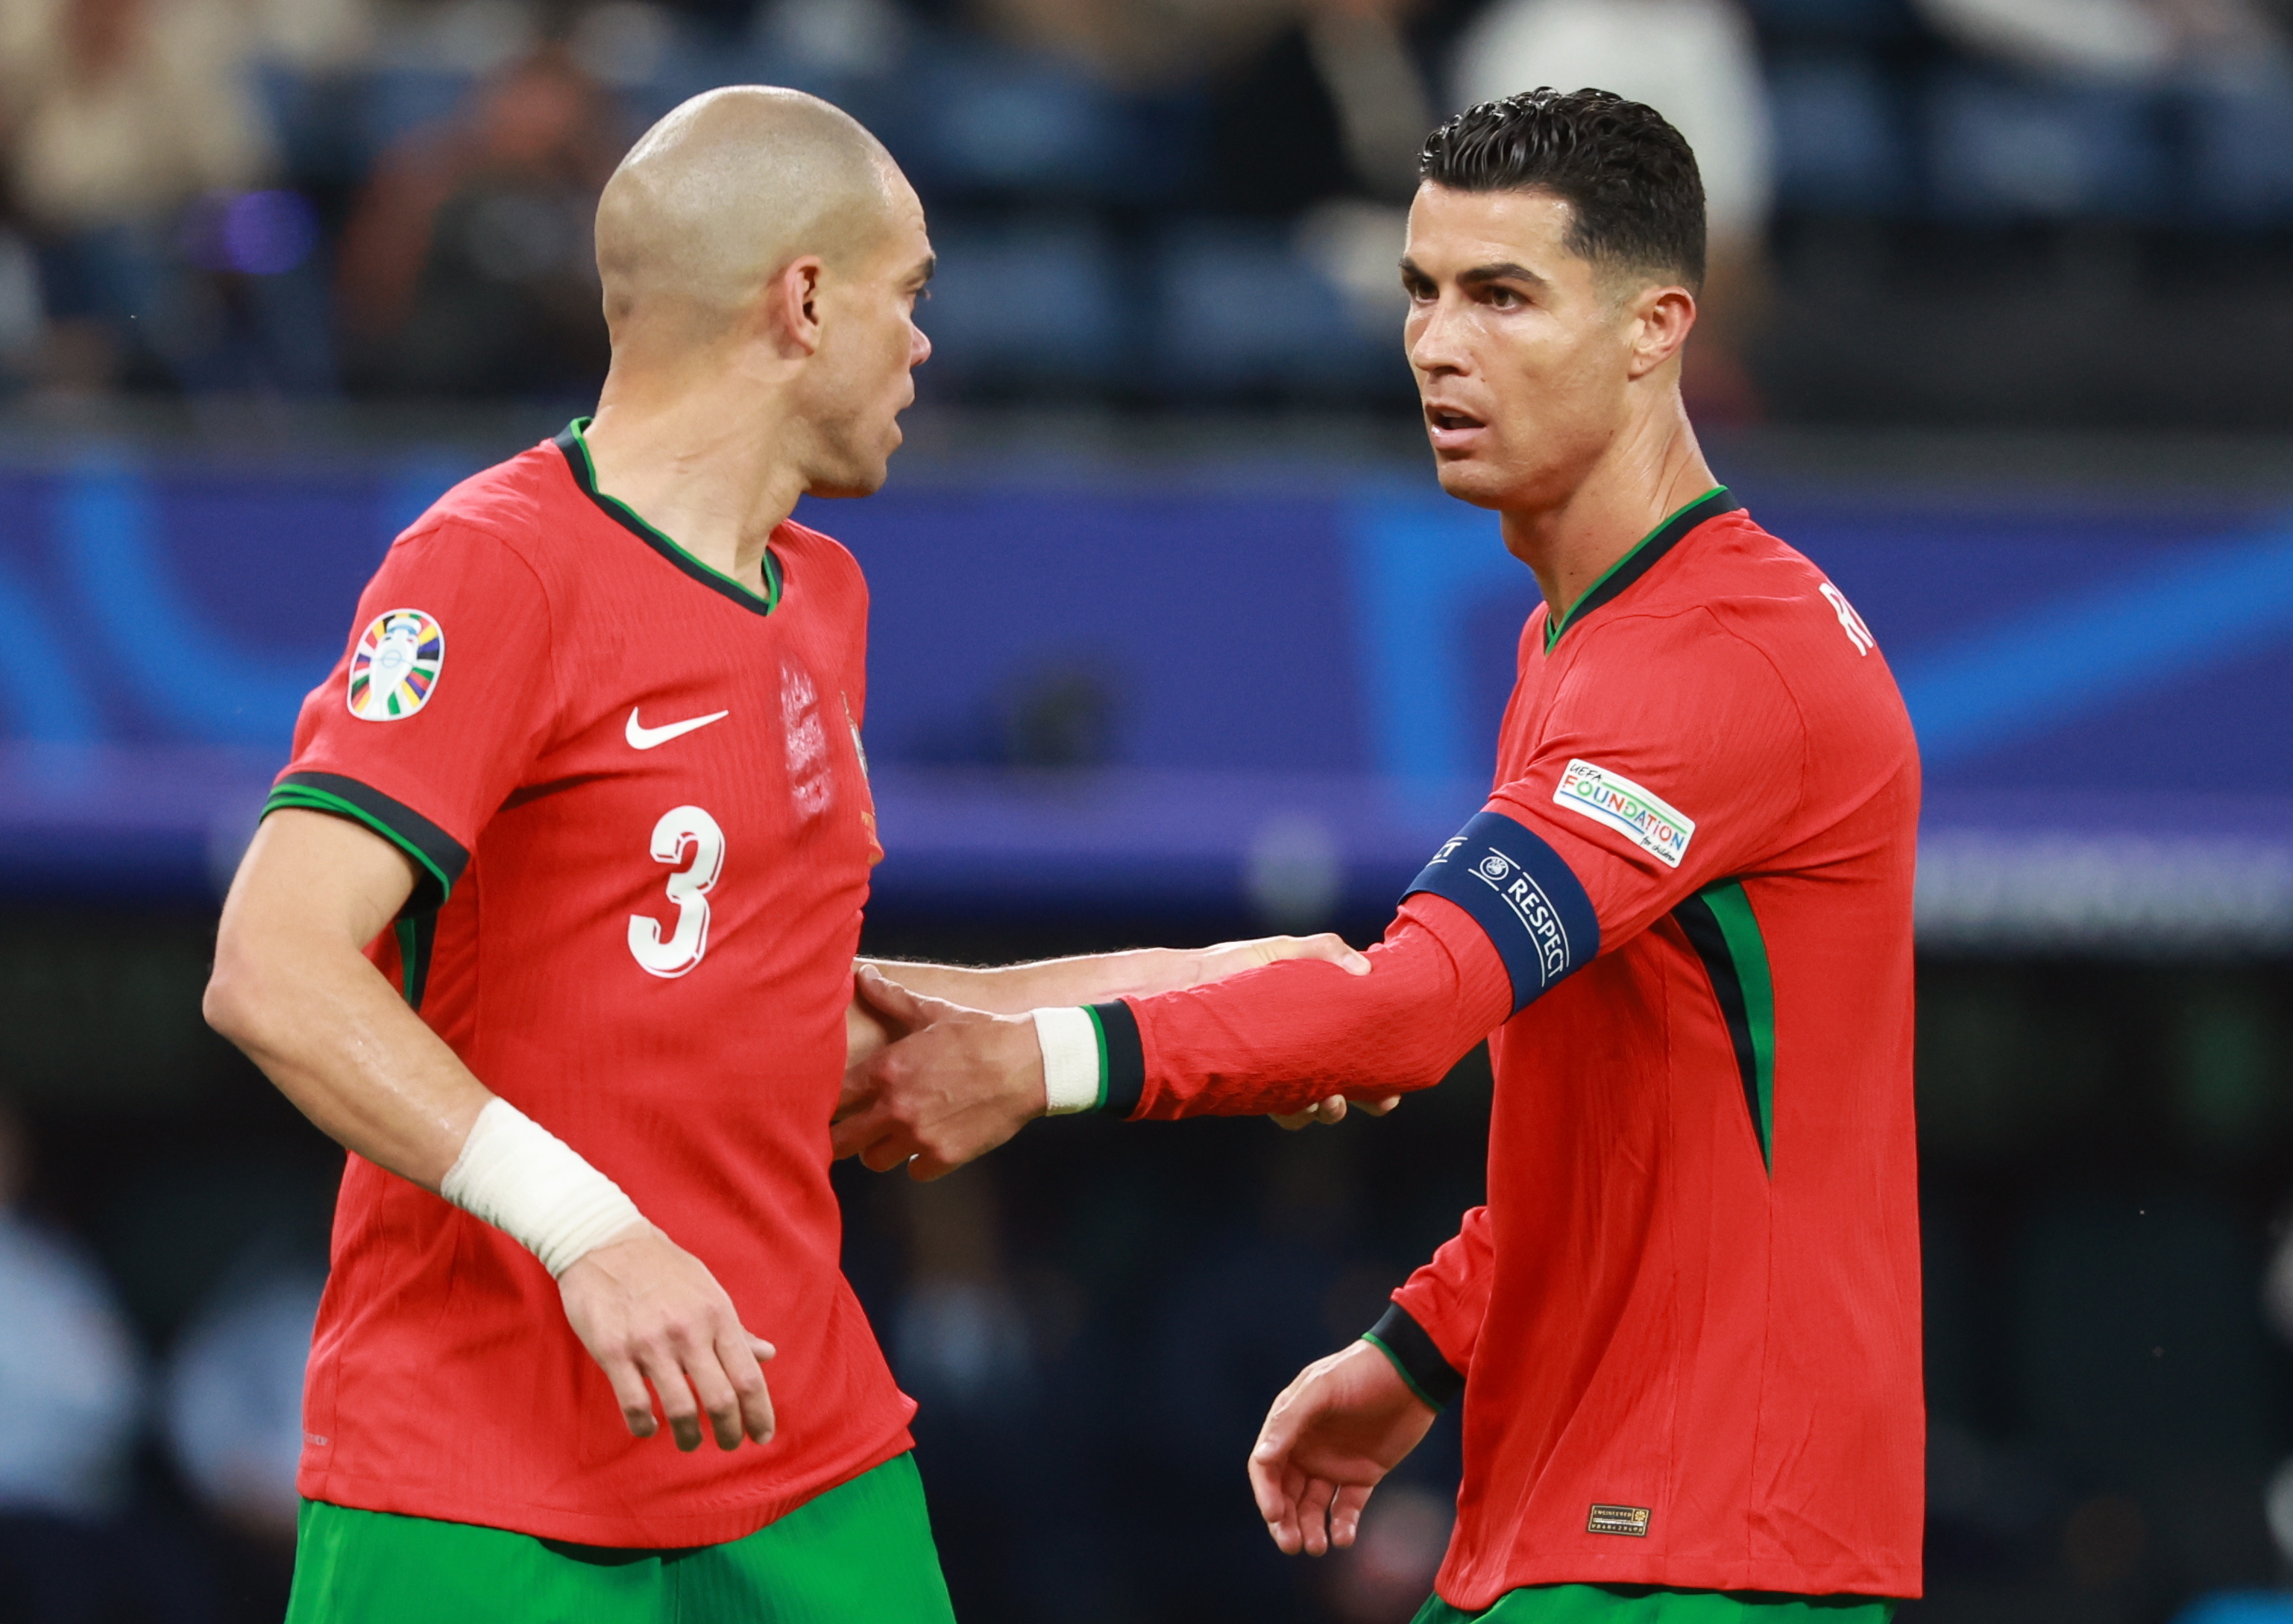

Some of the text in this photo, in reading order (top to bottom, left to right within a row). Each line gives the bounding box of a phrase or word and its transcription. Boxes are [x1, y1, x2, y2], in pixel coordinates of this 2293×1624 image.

[1570, 763, 1602, 782] UEFA
[1562, 774, 1685, 851] FOUNDATION
[1641, 836, 1676, 863] for children
[627, 805, 726, 978] 3
[1507, 878, 1564, 978] RESPECT
